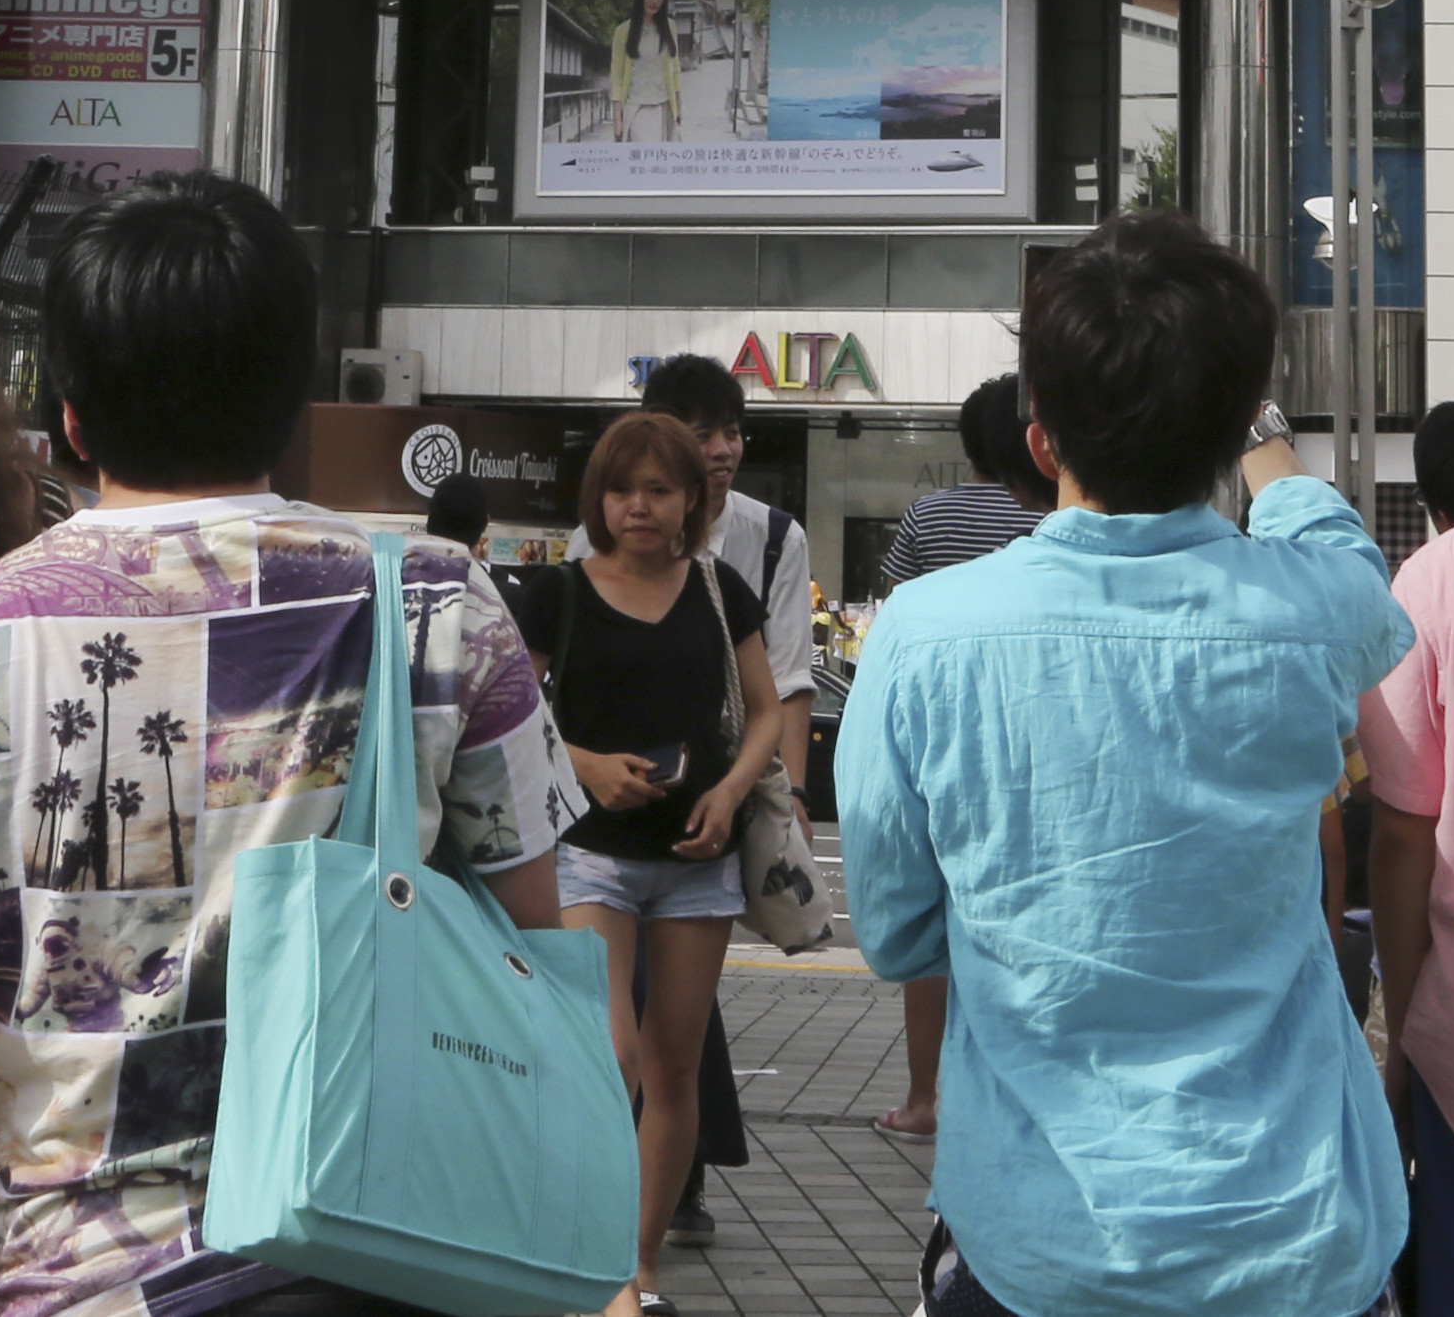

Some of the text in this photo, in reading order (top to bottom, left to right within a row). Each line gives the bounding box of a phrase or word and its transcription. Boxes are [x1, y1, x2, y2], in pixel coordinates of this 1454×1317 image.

[50, 52, 144, 64] animegoods
[151, 29, 197, 77] 5F
[31, 66, 54, 78] CD
[68, 67, 102, 78] DVD
[111, 68, 142, 79] etc.
[49, 98, 121, 126] ALTA
[730, 330, 877, 390] ALTA
[469, 448, 518, 480] Croissant
[520, 451, 558, 490] Taiyaki
